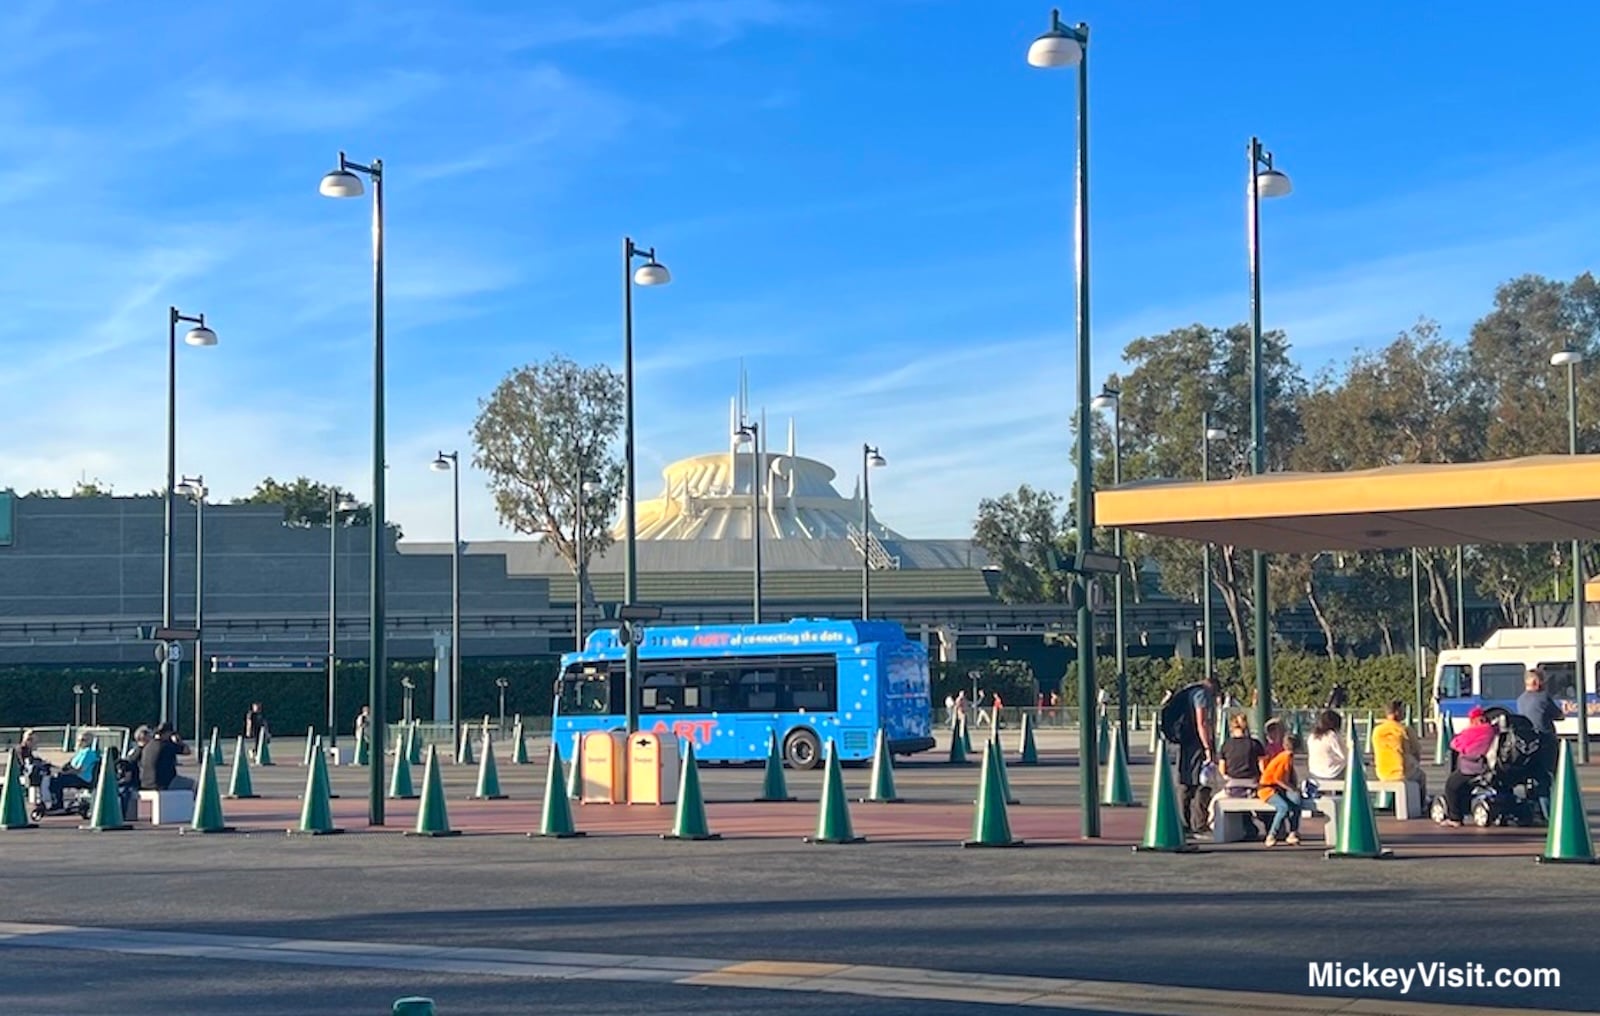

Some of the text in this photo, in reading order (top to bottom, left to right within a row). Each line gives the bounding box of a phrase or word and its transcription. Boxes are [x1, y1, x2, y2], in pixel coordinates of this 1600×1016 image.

[672, 635, 688, 647] the
[730, 633, 742, 647] of
[743, 633, 800, 646] connecting
[800, 630, 818, 643] the
[820, 630, 843, 643] dots
